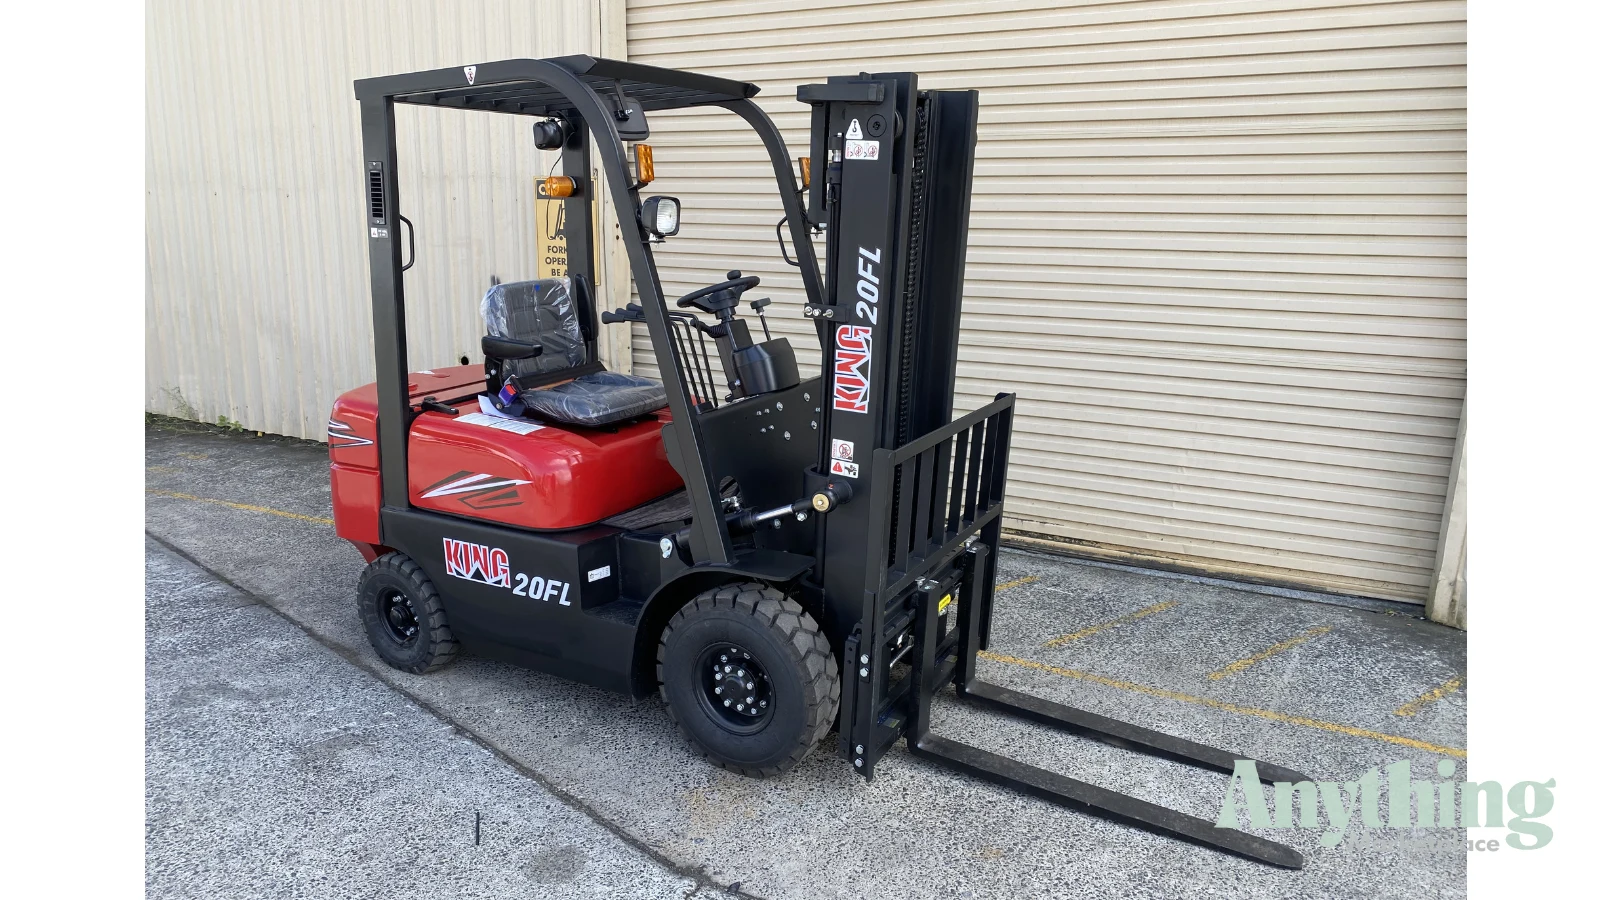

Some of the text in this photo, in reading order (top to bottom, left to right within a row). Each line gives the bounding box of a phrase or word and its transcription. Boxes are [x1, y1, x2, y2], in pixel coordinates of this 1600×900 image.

[551, 268, 561, 277] BE
[833, 246, 882, 414] KING 20FL
[442, 537, 572, 607] KING 20FL
